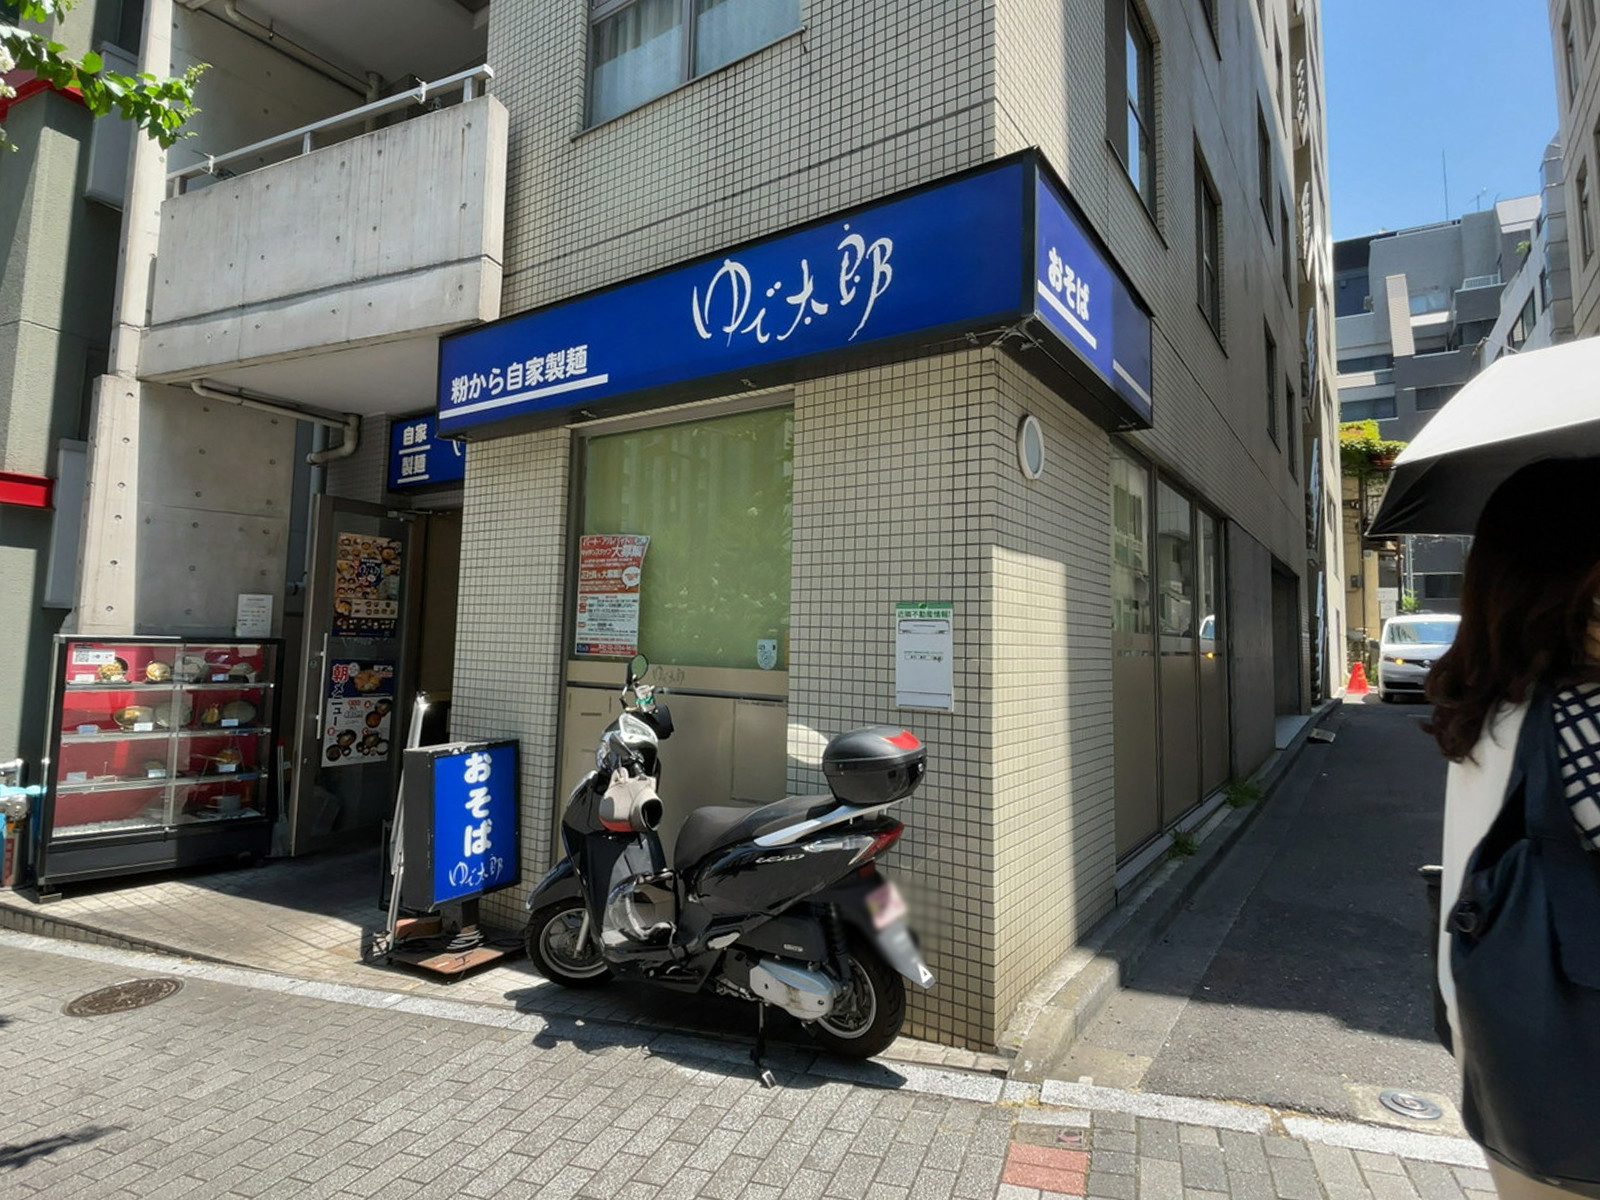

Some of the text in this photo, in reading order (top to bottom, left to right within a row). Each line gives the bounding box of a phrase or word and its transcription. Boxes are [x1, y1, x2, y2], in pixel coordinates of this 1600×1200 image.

[692, 223, 893, 347] ゆで太郎
[1048, 246, 1090, 321] おそば
[451, 344, 588, 404] 粉から自家製麺
[403, 423, 428, 446] 自家
[463, 752, 493, 858] おそば
